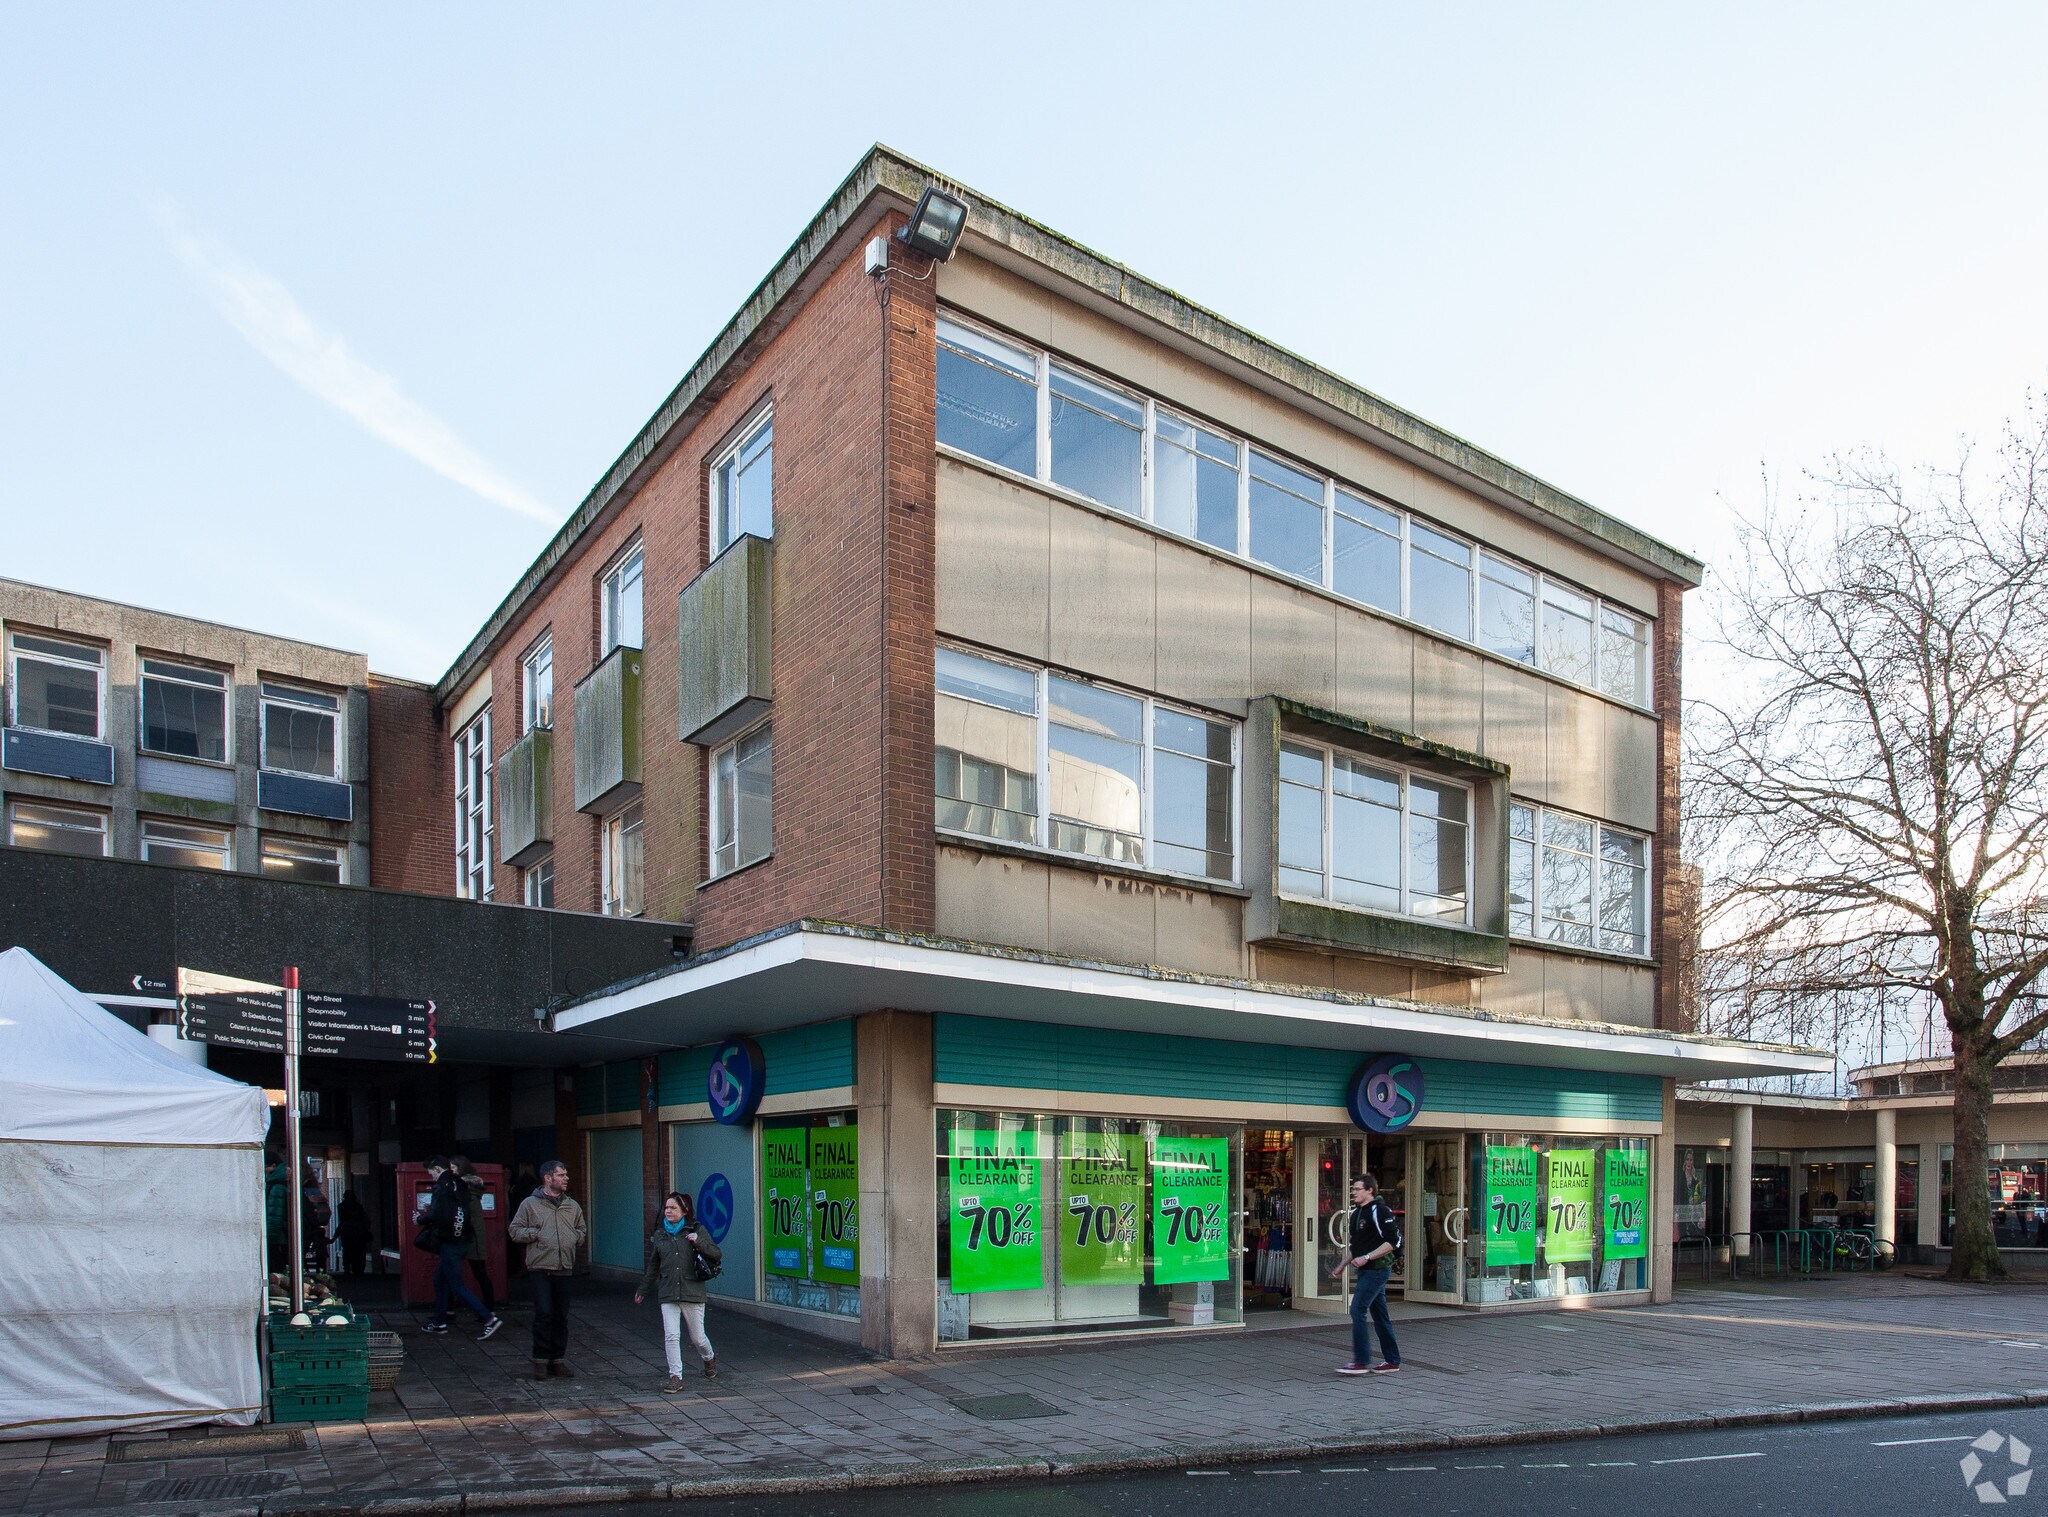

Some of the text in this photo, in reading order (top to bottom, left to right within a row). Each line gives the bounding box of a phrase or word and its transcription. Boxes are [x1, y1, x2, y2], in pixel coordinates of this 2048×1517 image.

[236, 996, 248, 1004] NHS
[267, 1002, 282, 1010] Centre
[307, 994, 322, 1002] High
[268, 1015, 282, 1023] Centre
[307, 1008, 347, 1016] Shopmobility
[328, 1022, 362, 1030] Information
[214, 1034, 230, 1042] Public
[230, 1036, 246, 1044] Toilets
[308, 1046, 338, 1054] Cathedral
[1367, 1063, 1416, 1126] QS
[768, 1142, 802, 1165] FINAL
[814, 1142, 854, 1166] FINAL
[960, 1146, 1034, 1170] FINAL
[1071, 1148, 1138, 1172] FINAL
[1162, 1152, 1222, 1174] FINAL
[1492, 1158, 1532, 1176] FINAL
[1552, 1161, 1589, 1178] FINAL
[1610, 1160, 1644, 1176] FINAL
[768, 1167, 802, 1179] CLEARANCE
[814, 1168, 855, 1180] CLEARANCE
[960, 1173, 1034, 1185] CLEARANCE
[1071, 1173, 1138, 1186] CLEARANCE
[1162, 1176, 1222, 1188] CLEARANCE
[1492, 1178, 1532, 1187] CLEARANCE
[1551, 1180, 1588, 1188] CLEARANCE
[1610, 1178, 1644, 1187] CLEARANCE
[454, 1206, 465, 1238] adidas
[770, 1195, 804, 1237] 70% OFF
[816, 1197, 858, 1242] 70% OFF
[1492, 1200, 1532, 1234] 70% OFF
[1550, 1201, 1588, 1234] 70% OFF
[1609, 1199, 1643, 1230] 70% OFF
[959, 1203, 1035, 1251] 70% OFF
[1069, 1202, 1138, 1246] 70% OFF
[1160, 1202, 1222, 1246] 70% OFF
[824, 1248, 852, 1259] MORE LINES
[830, 1258, 846, 1267] ADDED
